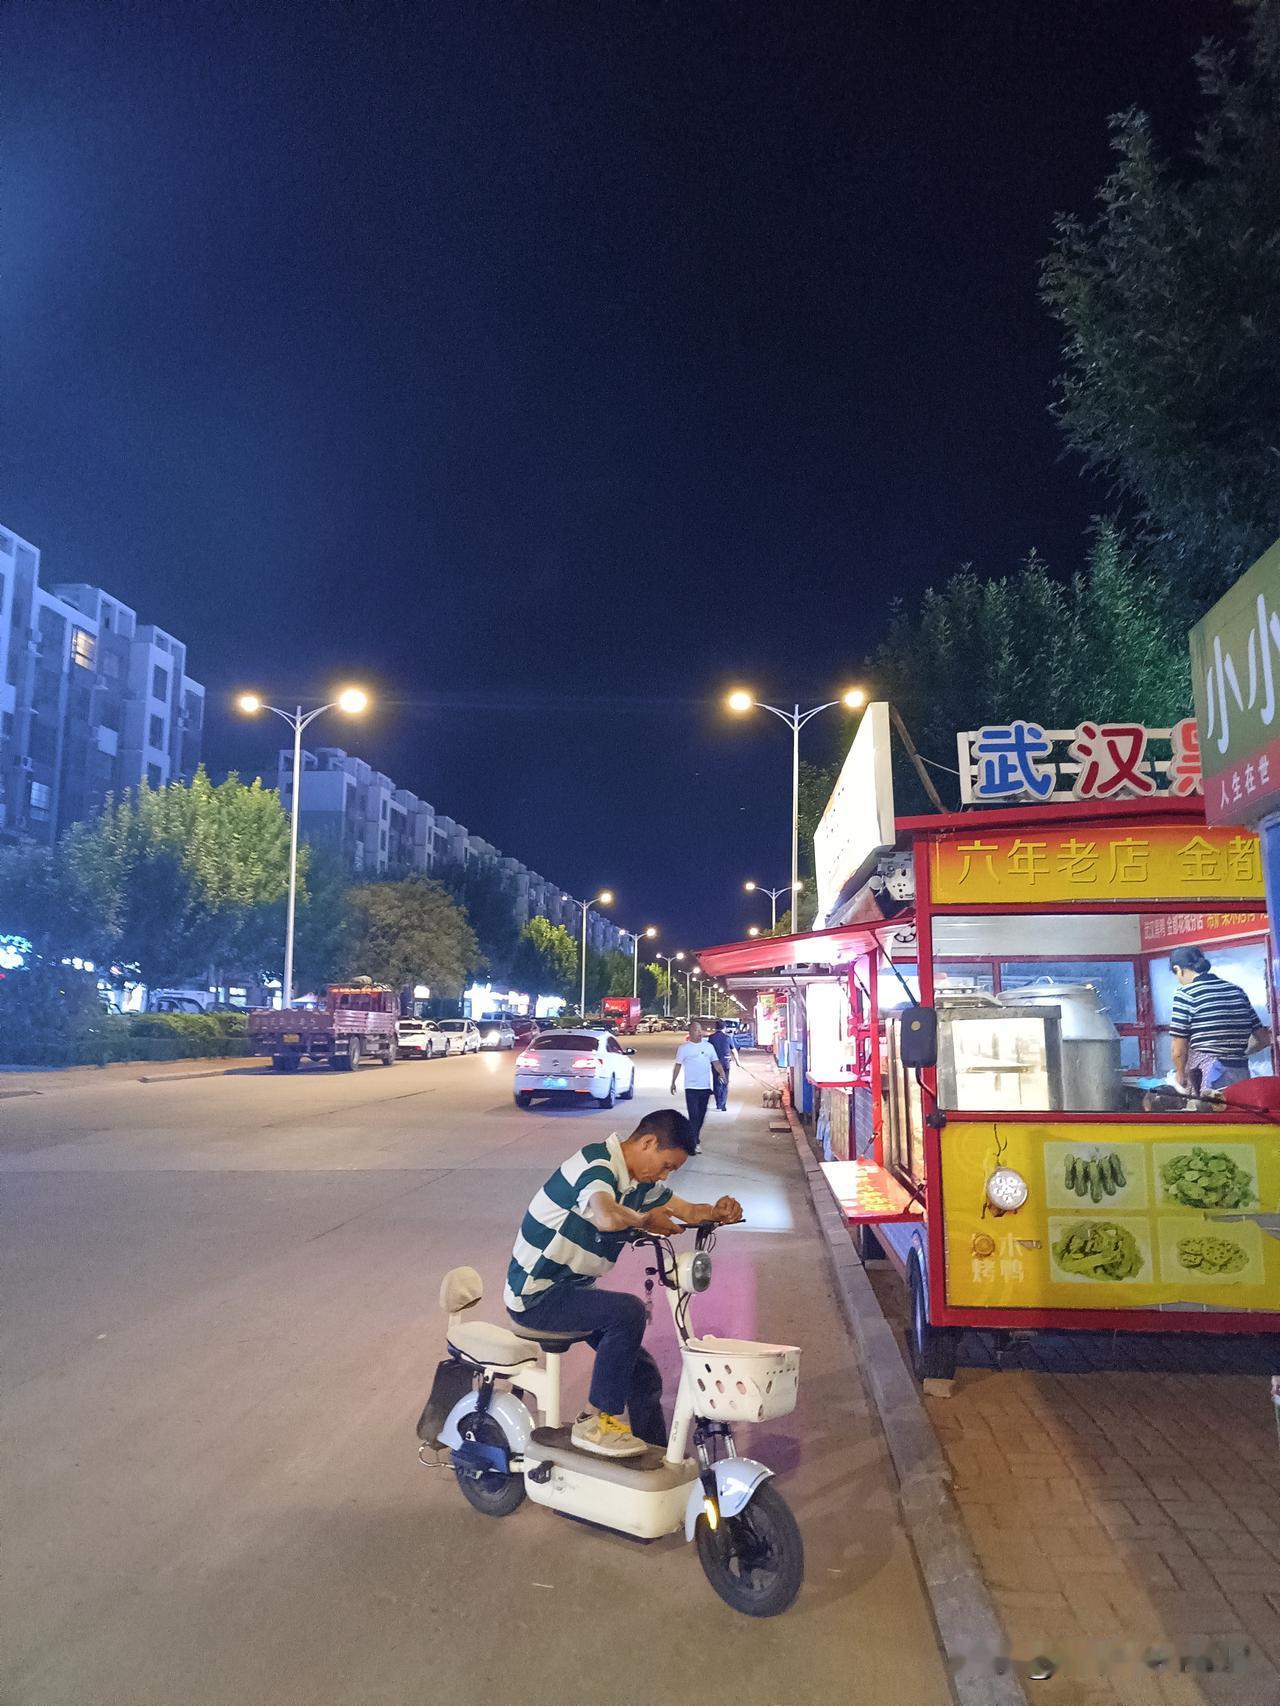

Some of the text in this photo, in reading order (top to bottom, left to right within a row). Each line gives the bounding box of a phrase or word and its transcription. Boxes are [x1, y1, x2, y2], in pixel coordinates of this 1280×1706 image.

[1220, 754, 1270, 809] 人生在世
[957, 838, 1151, 885] 六年老店
